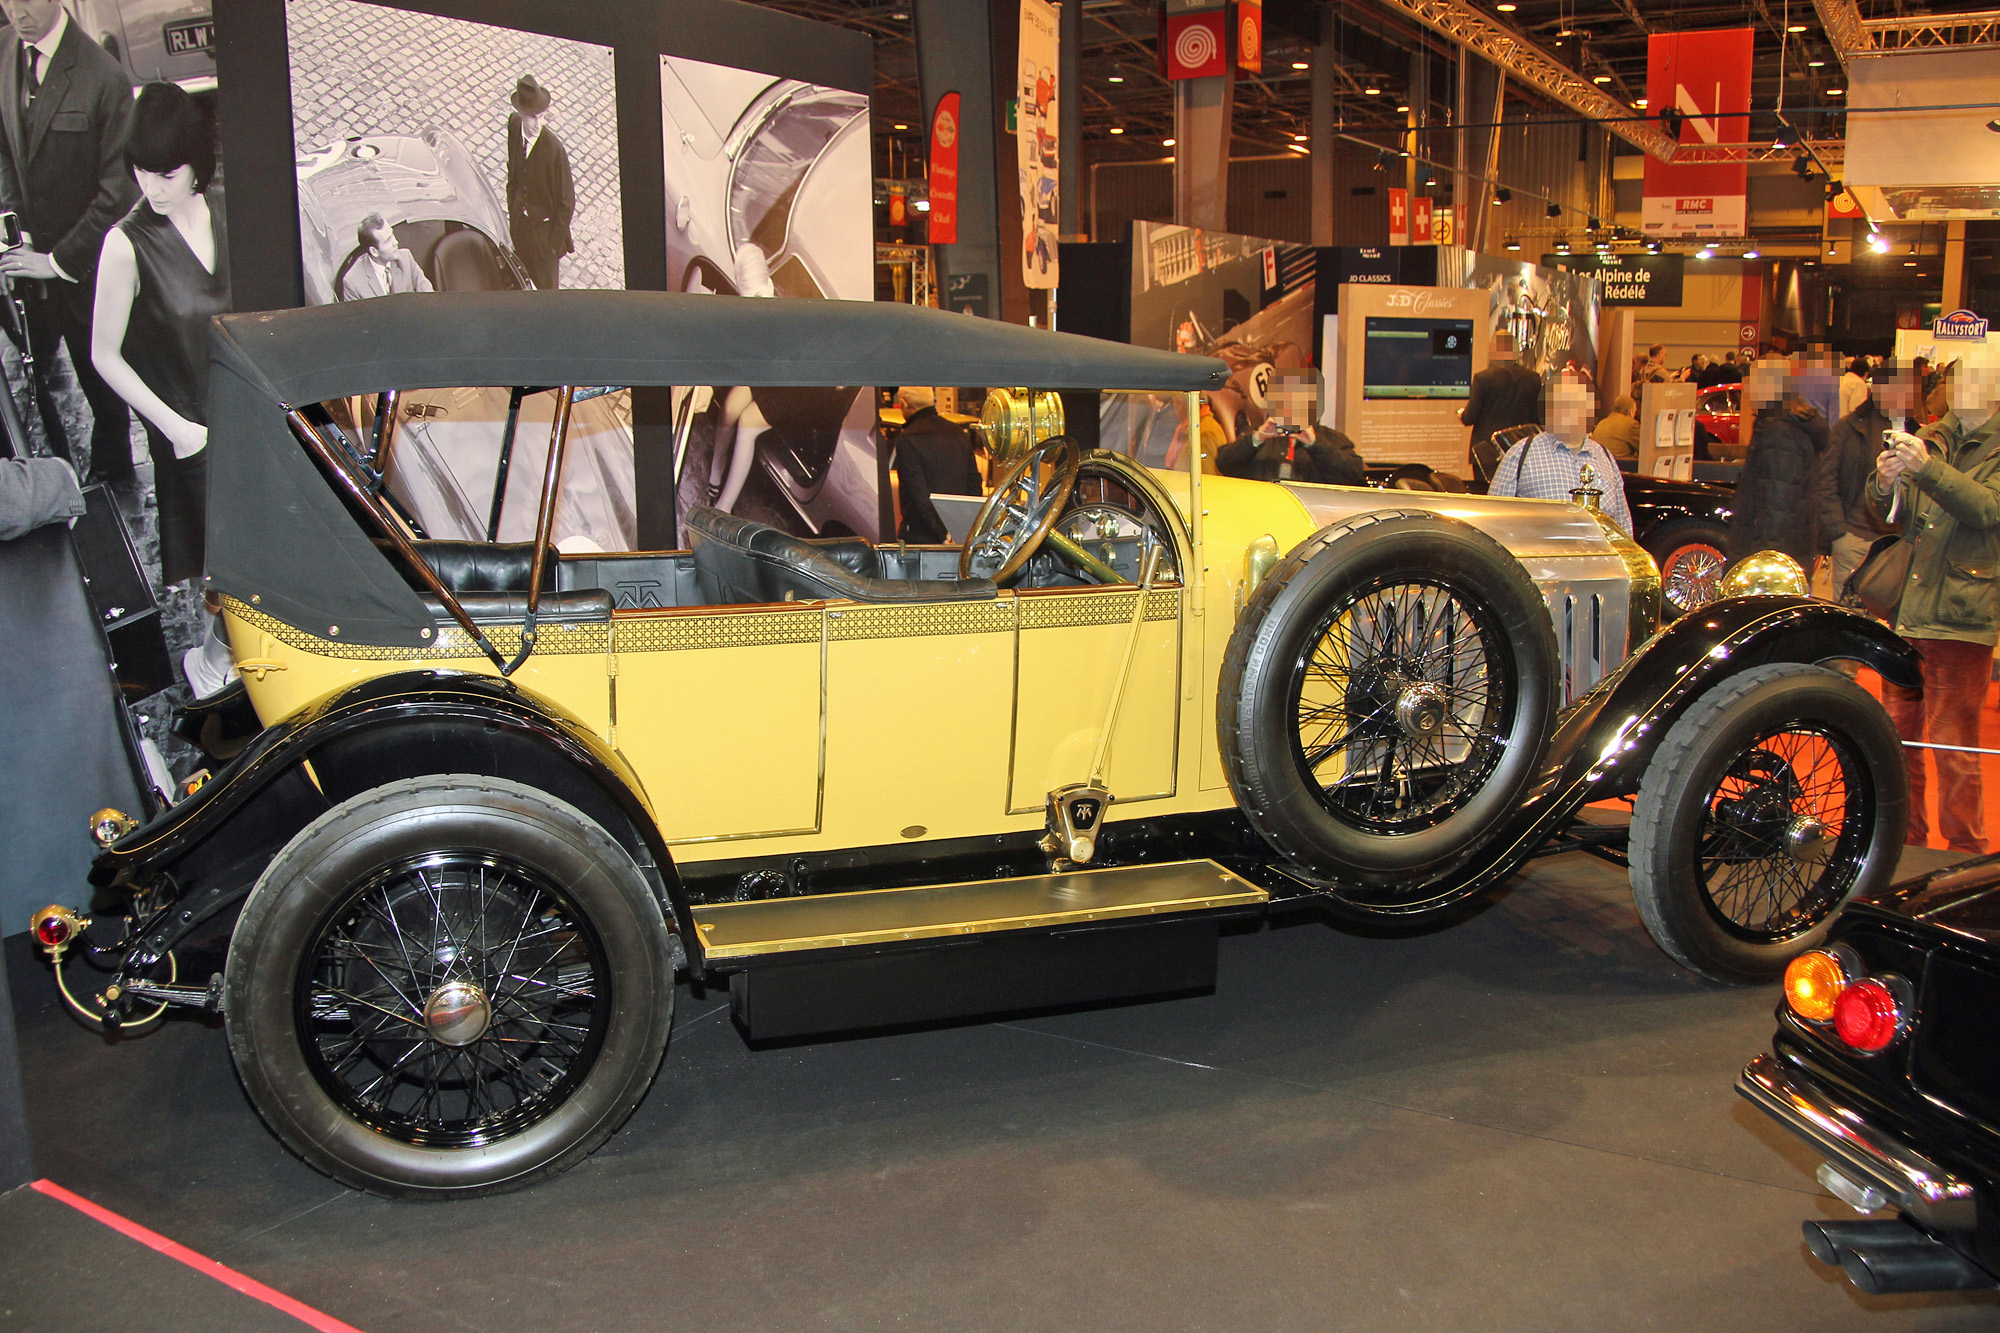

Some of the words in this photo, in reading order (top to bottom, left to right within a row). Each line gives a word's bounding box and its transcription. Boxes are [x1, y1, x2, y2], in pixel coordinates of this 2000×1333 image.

[170, 27, 208, 51] RLW
[1682, 200, 1707, 210] RMC
[1349, 274, 1358, 283] JD
[1358, 274, 1392, 283] CLASSICS
[1594, 267, 1632, 285] Alpine
[1634, 267, 1651, 283] de
[1604, 284, 1646, 299] Rédélé
[1936, 320, 1985, 336] RALLYSTORY
[1254, 619, 1277, 655] CORD
